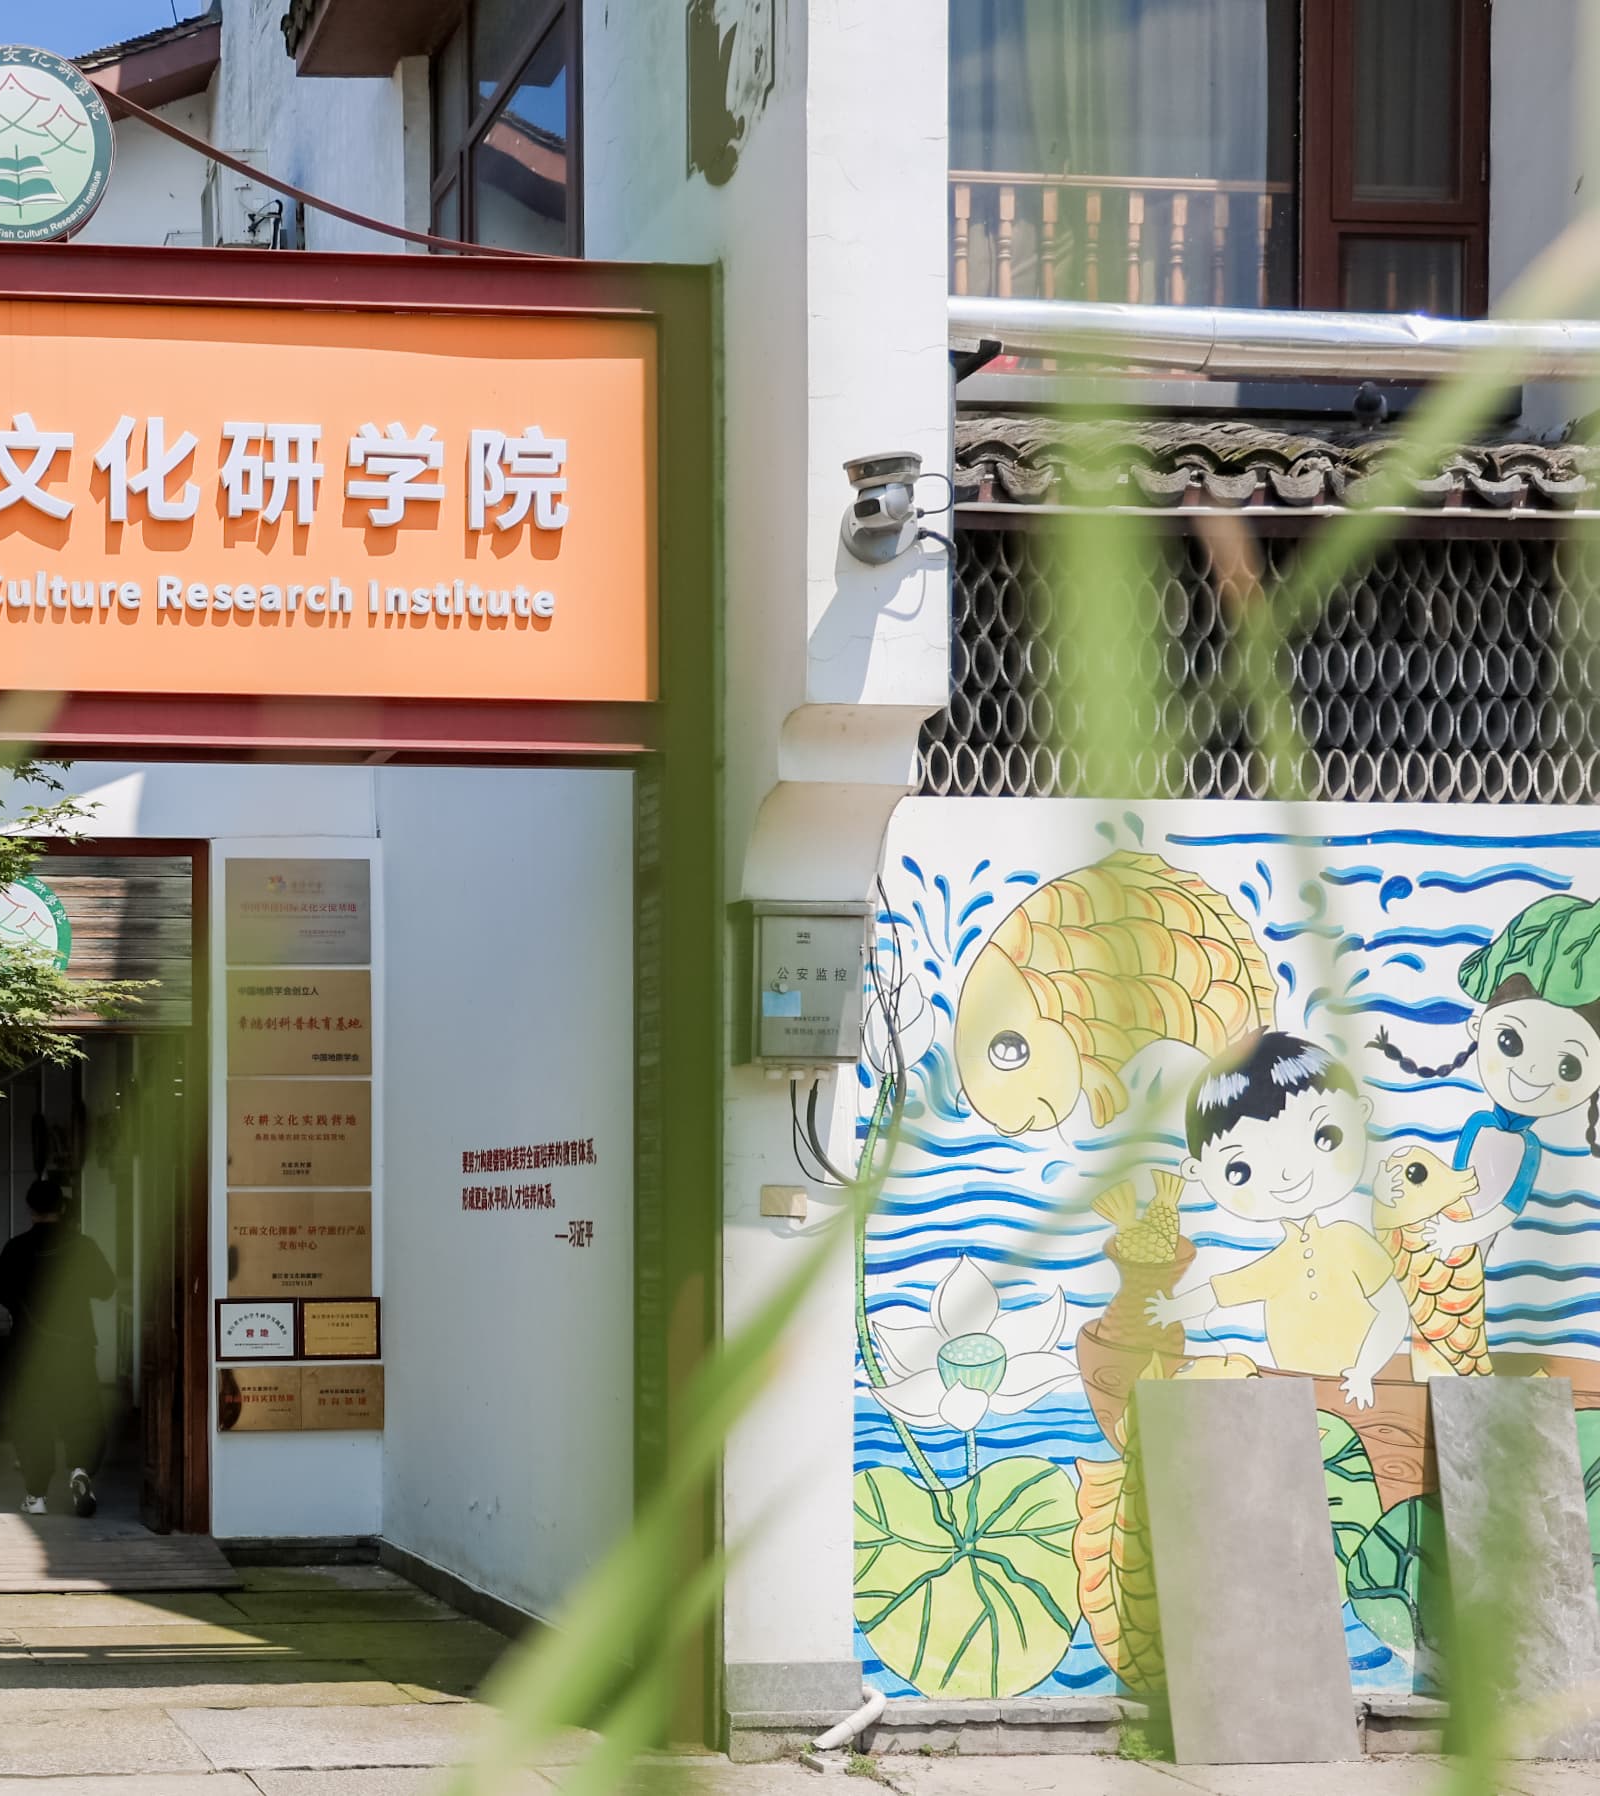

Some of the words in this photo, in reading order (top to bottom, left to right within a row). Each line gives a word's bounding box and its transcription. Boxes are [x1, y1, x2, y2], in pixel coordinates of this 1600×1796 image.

[17, 226, 49, 239] Culture
[50, 203, 86, 231] Research
[83, 170, 102, 205] Institute
[157, 575, 353, 615] Research
[368, 579, 555, 618] Institute
[777, 967, 847, 981] 公安监控
[243, 1114, 357, 1127] 农耕文化实践营地
[278, 1241, 318, 1251] 发布中心
